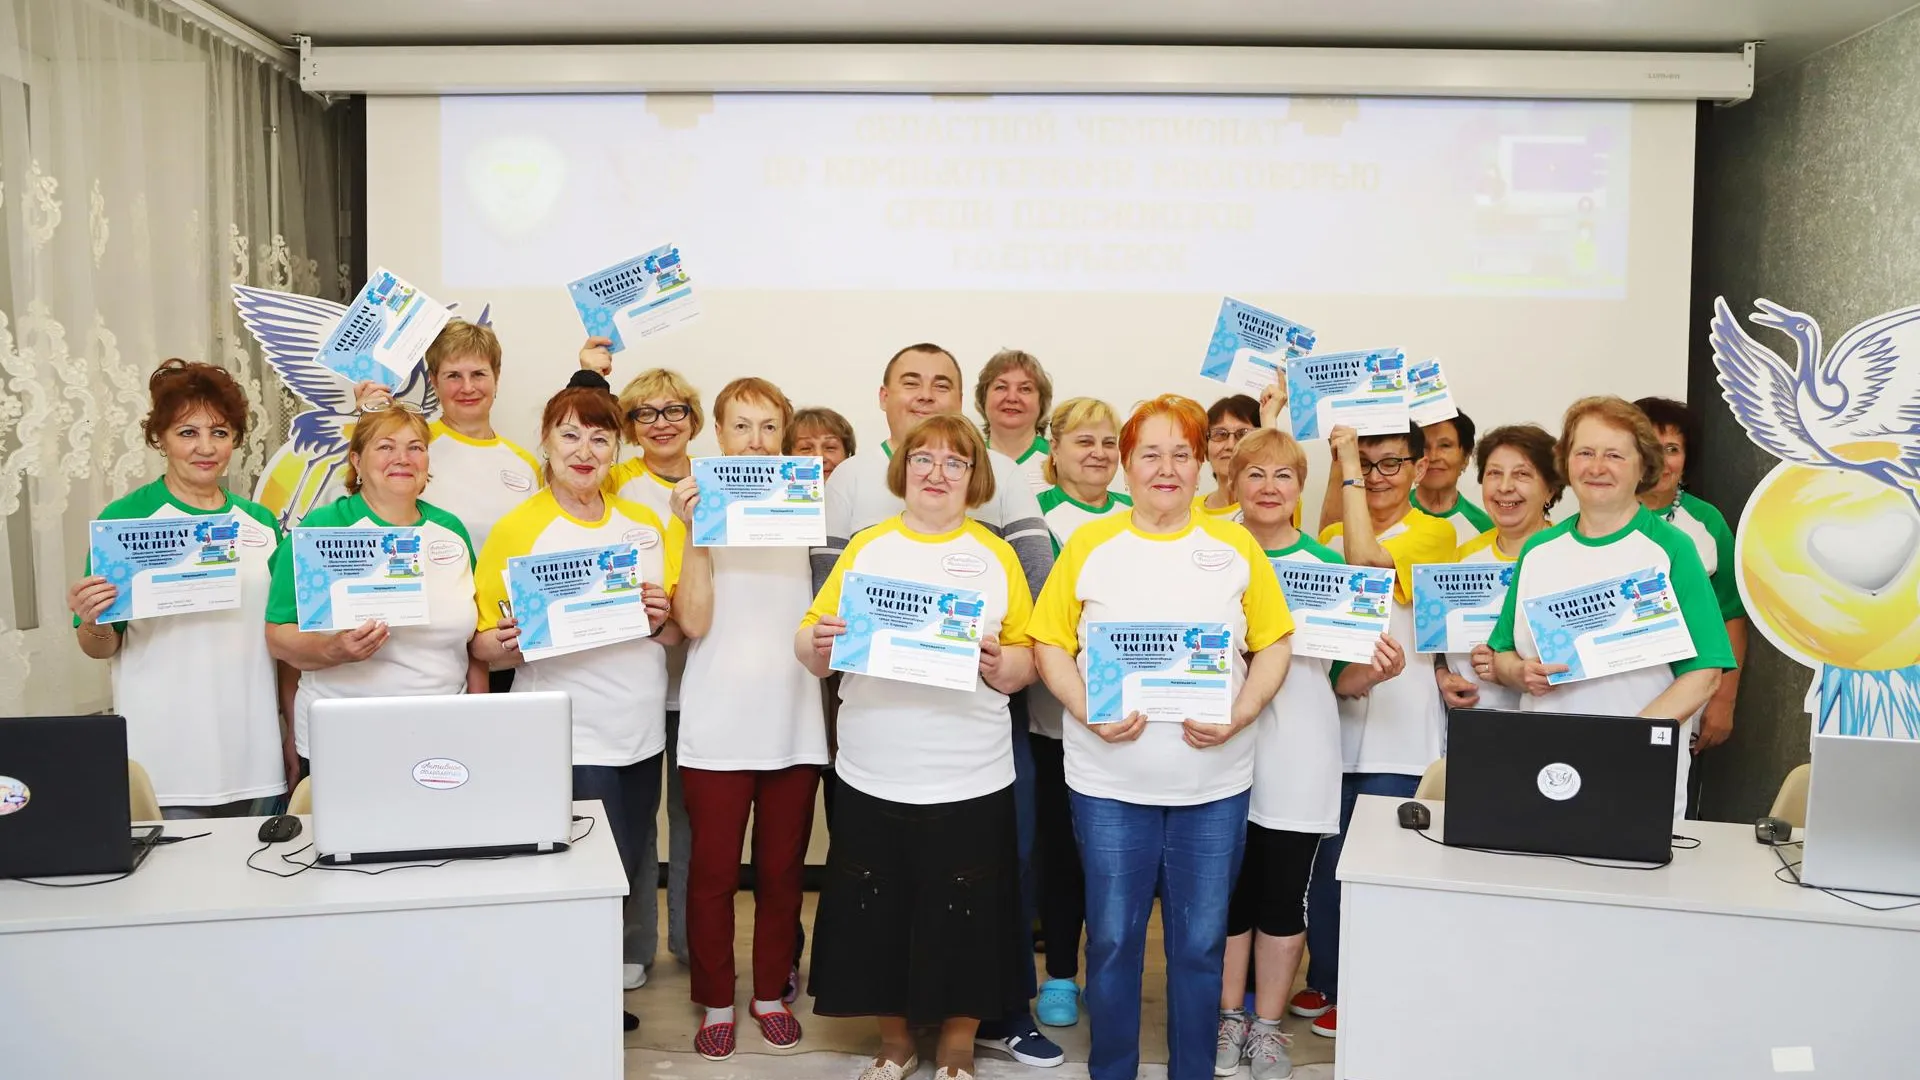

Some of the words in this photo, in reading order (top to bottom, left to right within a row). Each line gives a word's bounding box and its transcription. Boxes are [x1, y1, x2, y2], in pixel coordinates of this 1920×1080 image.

[118, 529, 189, 542] СЕРТИФИКАТ
[123, 539, 186, 551] УЧАСТНИКА
[1110, 633, 1178, 642] СЕРТИФИКАТ
[1114, 643, 1175, 652] УЧАСТНИКА
[1656, 731, 1665, 742] 4
